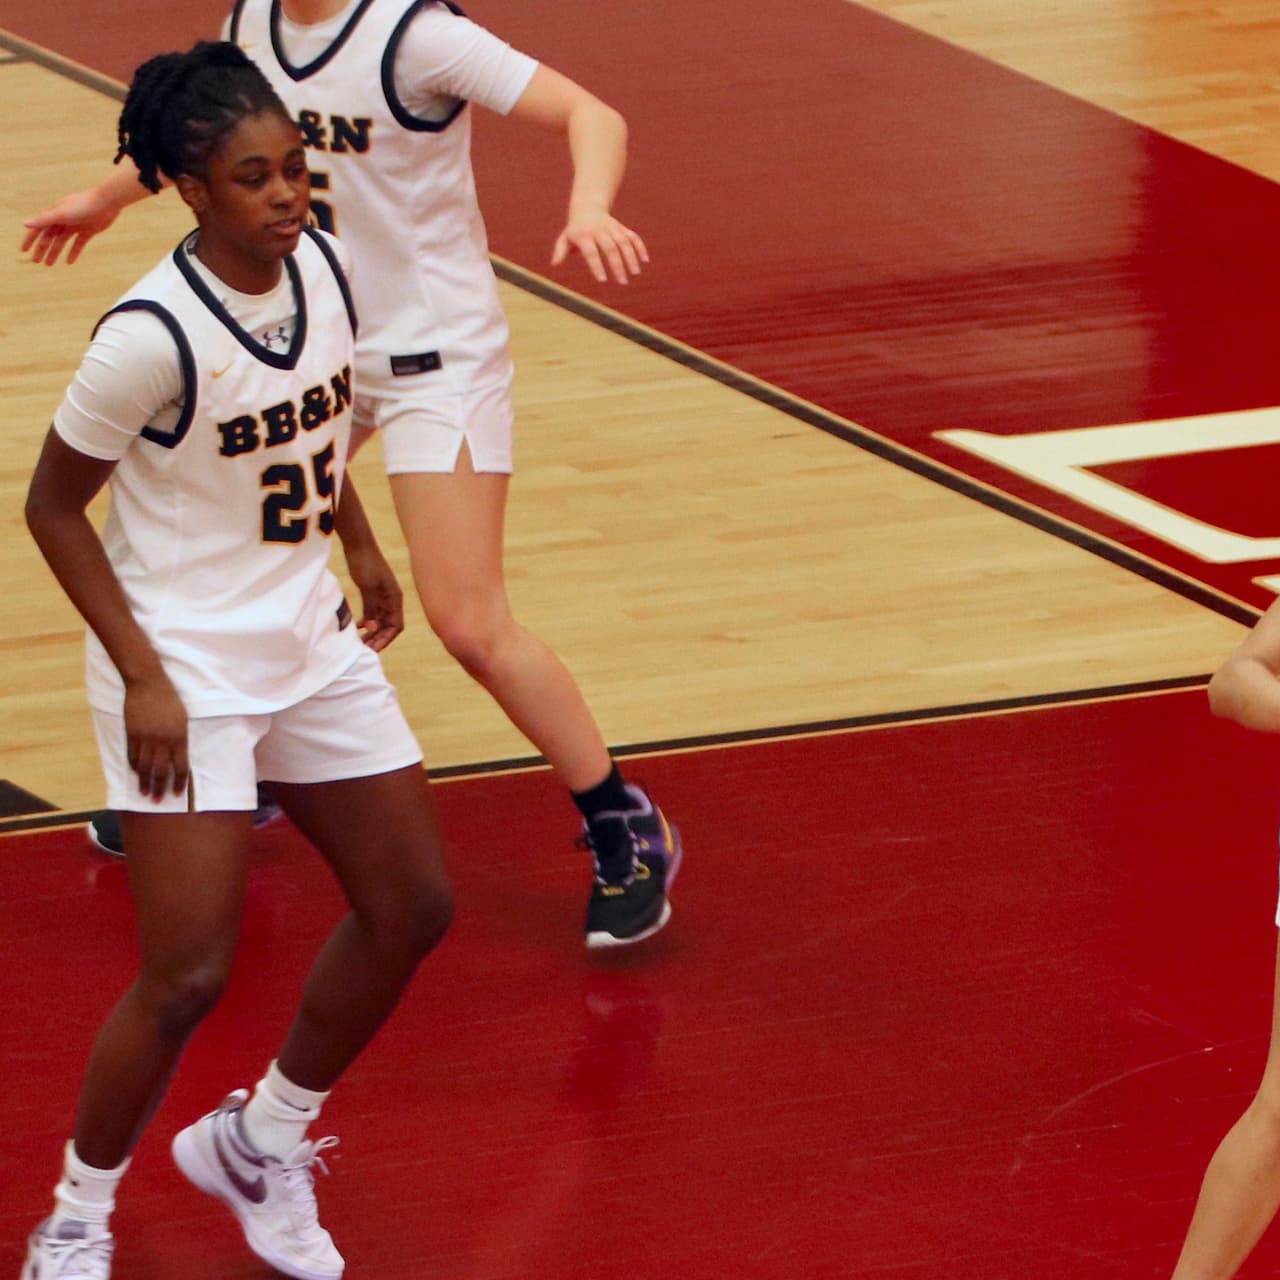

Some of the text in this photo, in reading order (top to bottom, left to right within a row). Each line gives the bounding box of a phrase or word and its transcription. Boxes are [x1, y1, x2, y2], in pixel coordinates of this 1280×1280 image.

[298, 108, 375, 154] &N
[217, 363, 352, 458] BB&N
[260, 440, 337, 545] 25
